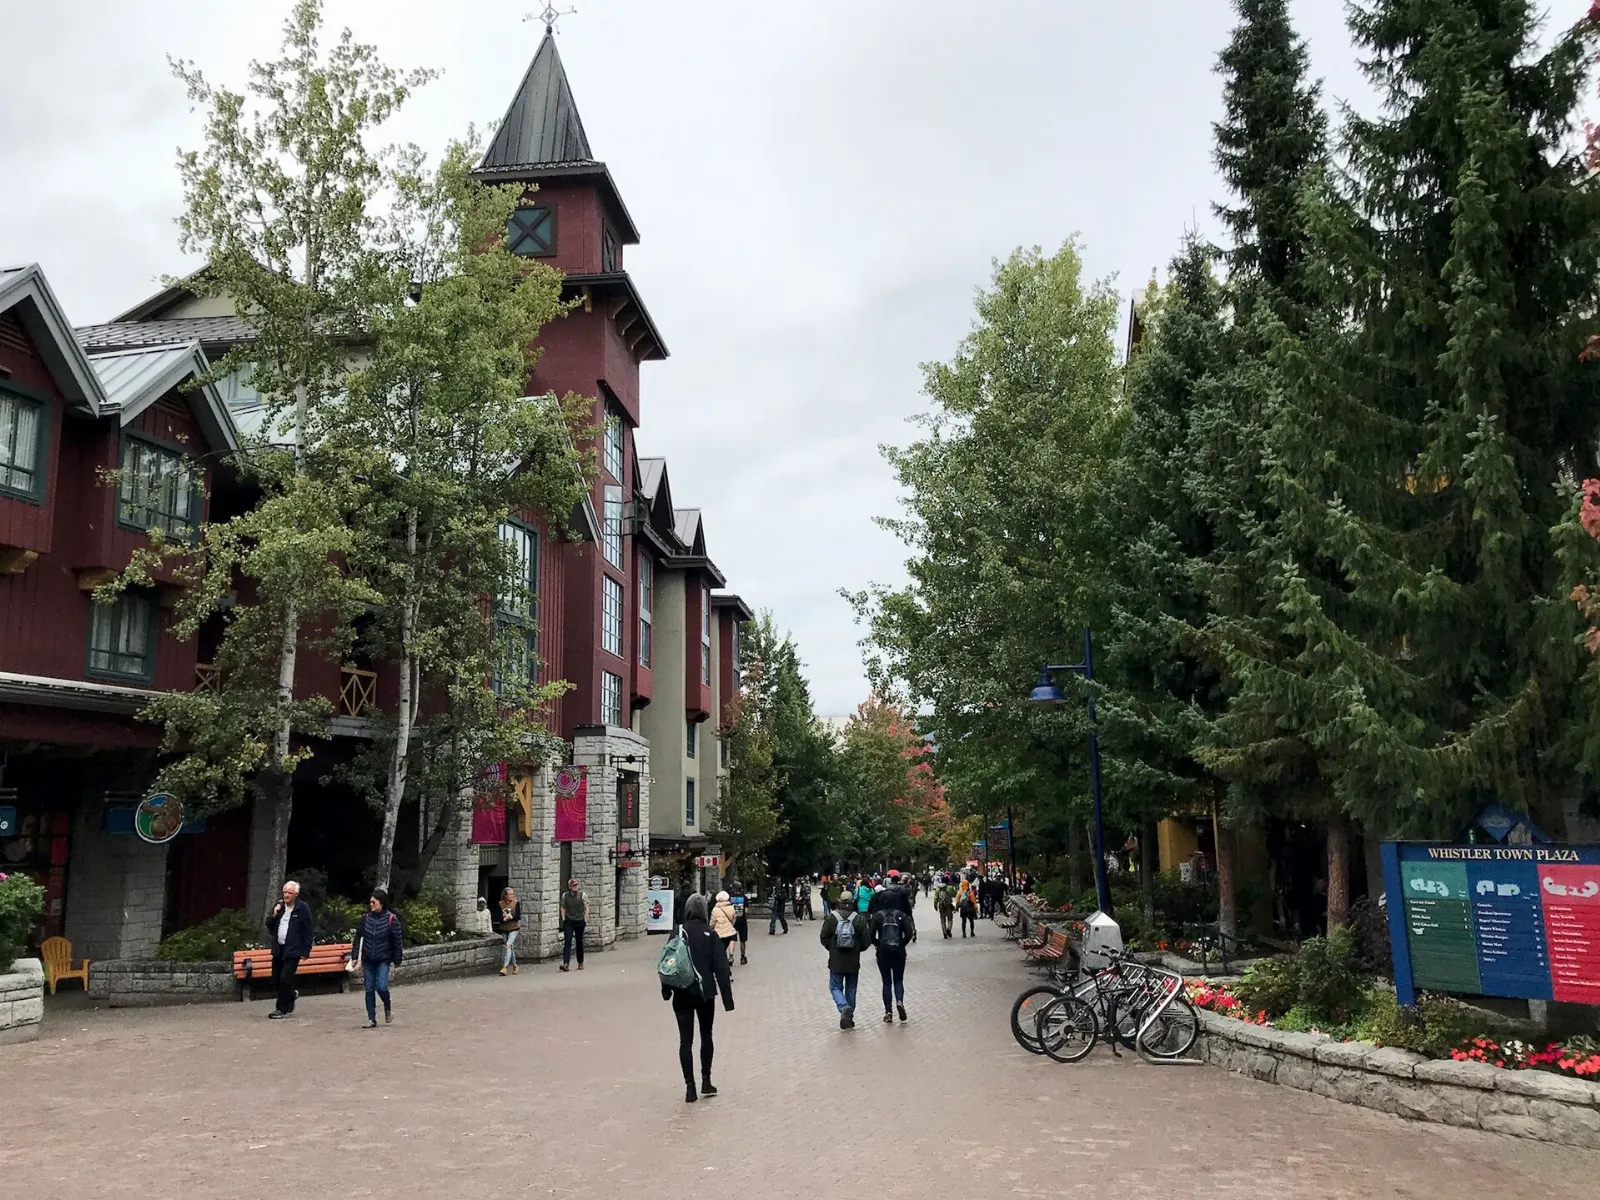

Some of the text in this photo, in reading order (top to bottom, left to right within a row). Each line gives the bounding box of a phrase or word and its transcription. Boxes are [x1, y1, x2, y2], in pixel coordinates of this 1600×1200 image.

[1428, 848, 1580, 861] WHISTLER TOWN PLAZA
